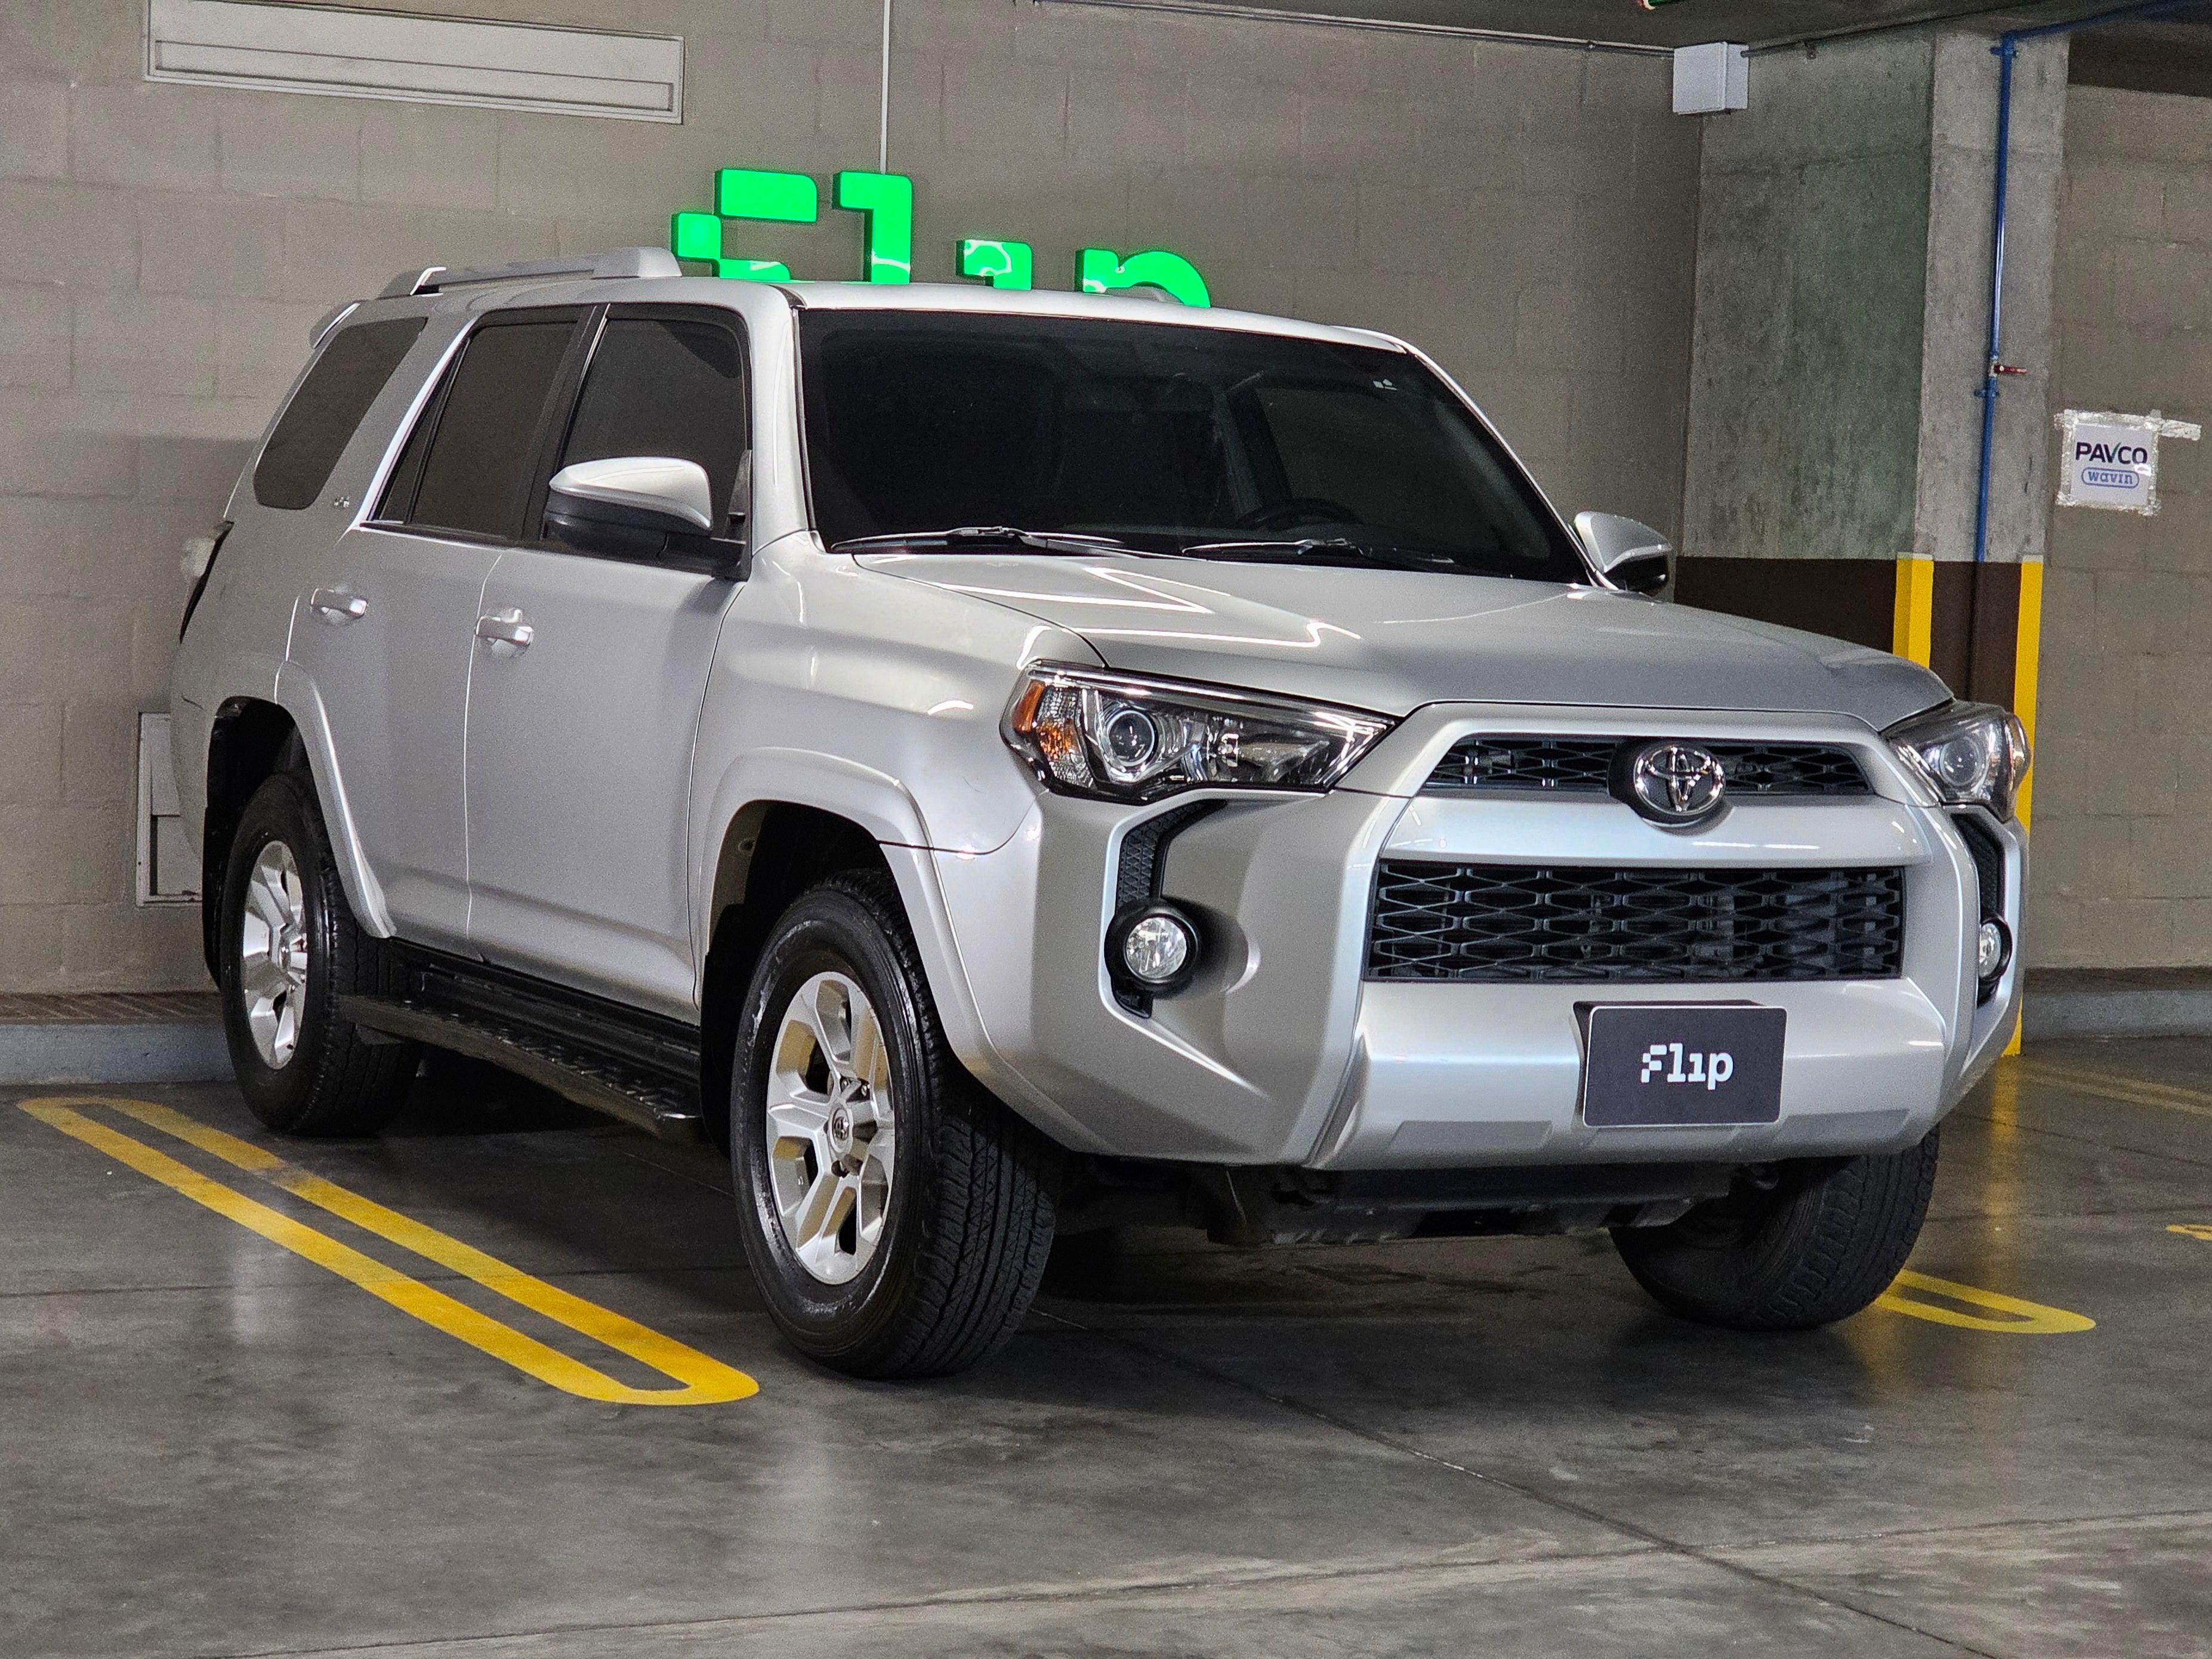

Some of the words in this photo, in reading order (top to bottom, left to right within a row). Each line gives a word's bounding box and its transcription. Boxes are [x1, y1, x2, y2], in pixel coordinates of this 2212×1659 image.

[2075, 441, 2148, 464] PAVCO
[2088, 471, 2133, 484] wavin
[1641, 1043, 1733, 1090] Flip
